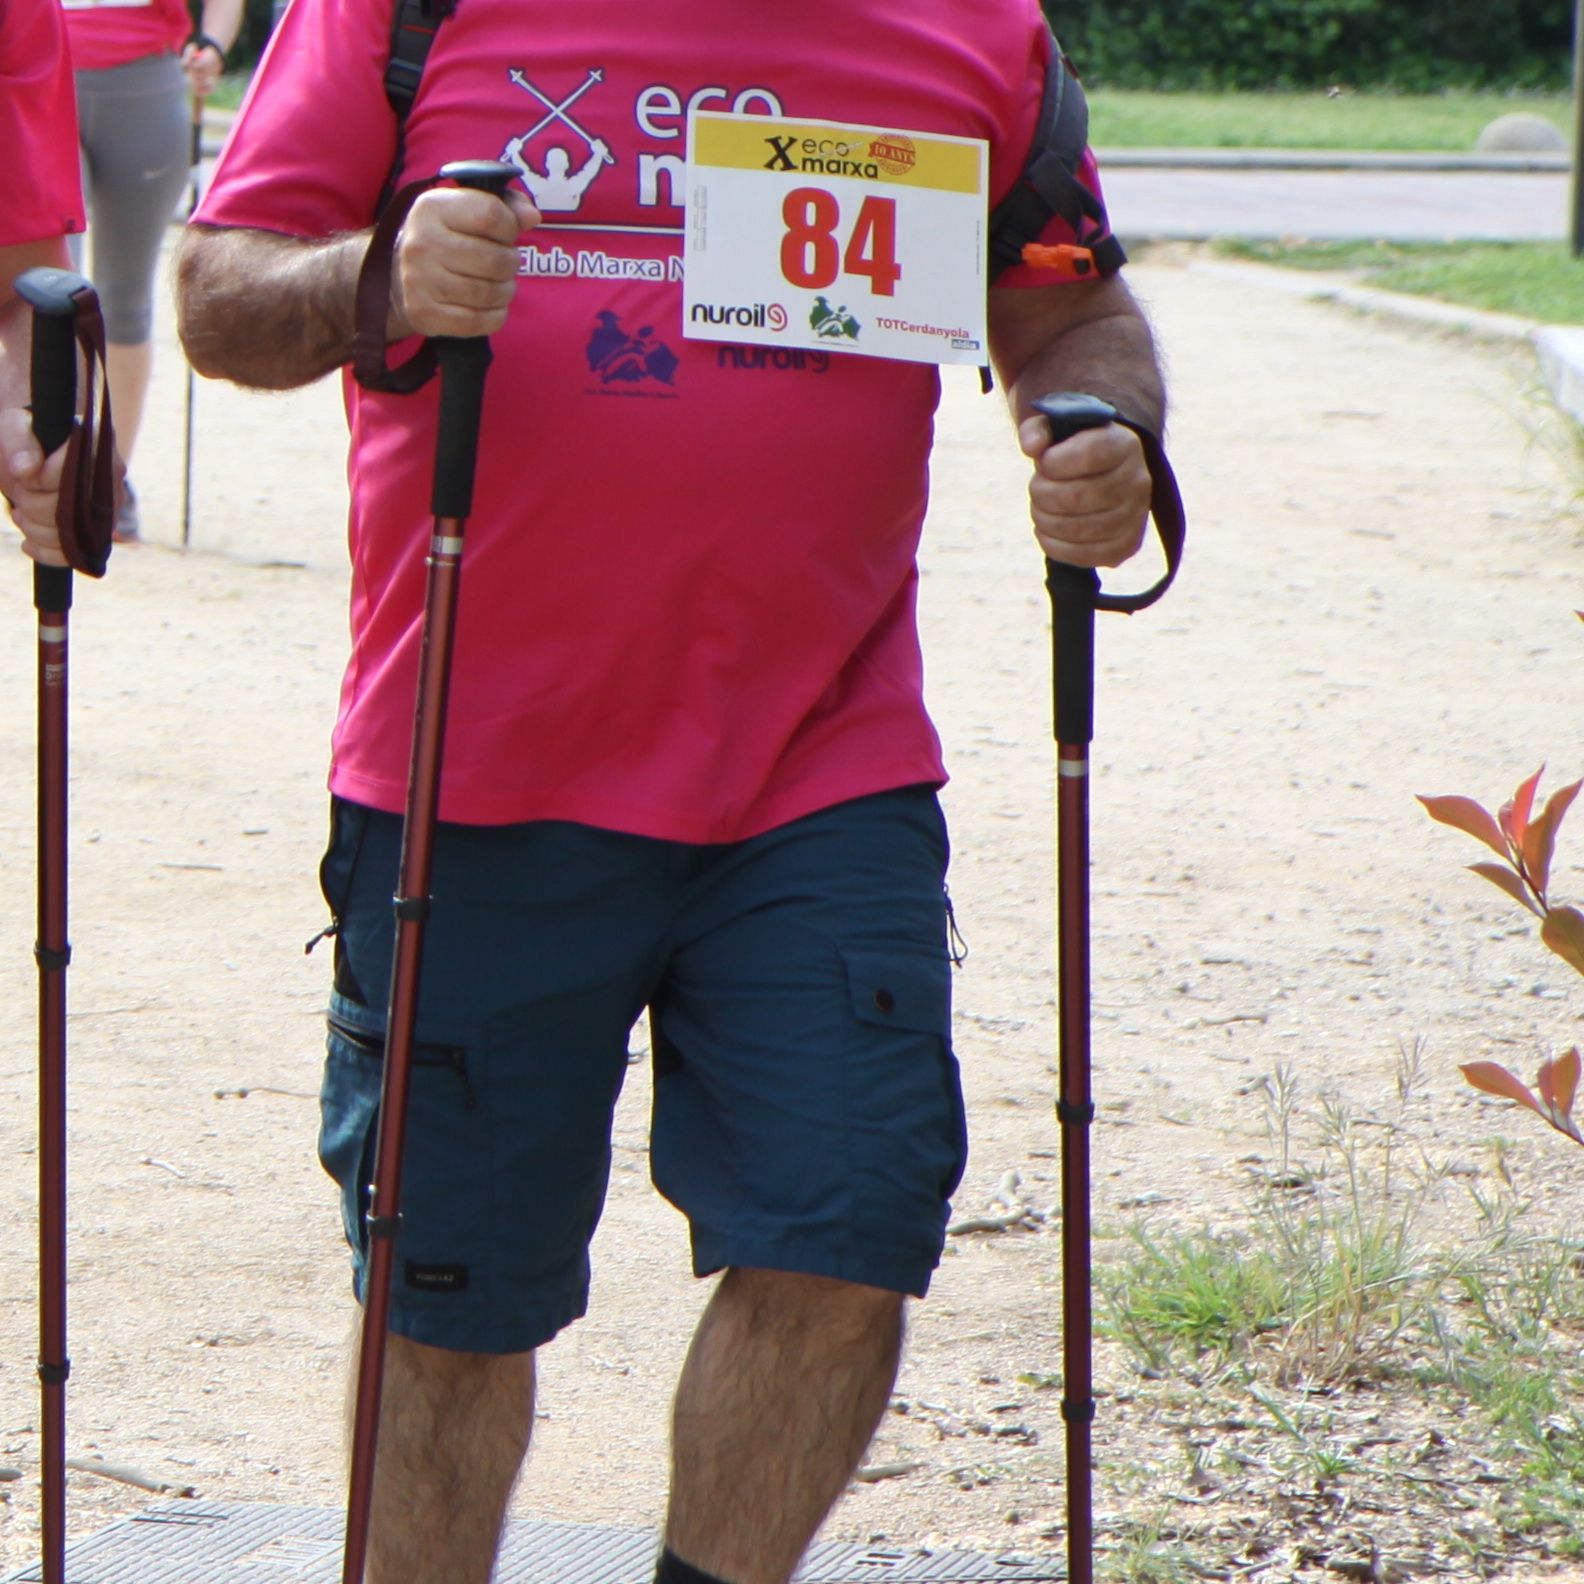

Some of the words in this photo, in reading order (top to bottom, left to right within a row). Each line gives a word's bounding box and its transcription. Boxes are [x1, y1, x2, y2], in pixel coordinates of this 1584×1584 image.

[764, 135, 799, 172] X
[802, 137, 851, 158] eco
[801, 157, 879, 179] marxa
[779, 186, 902, 297] 84
[578, 250, 664, 281] Marxa
[691, 302, 766, 328] nuroil
[875, 316, 970, 339] TOTCerdanyola
